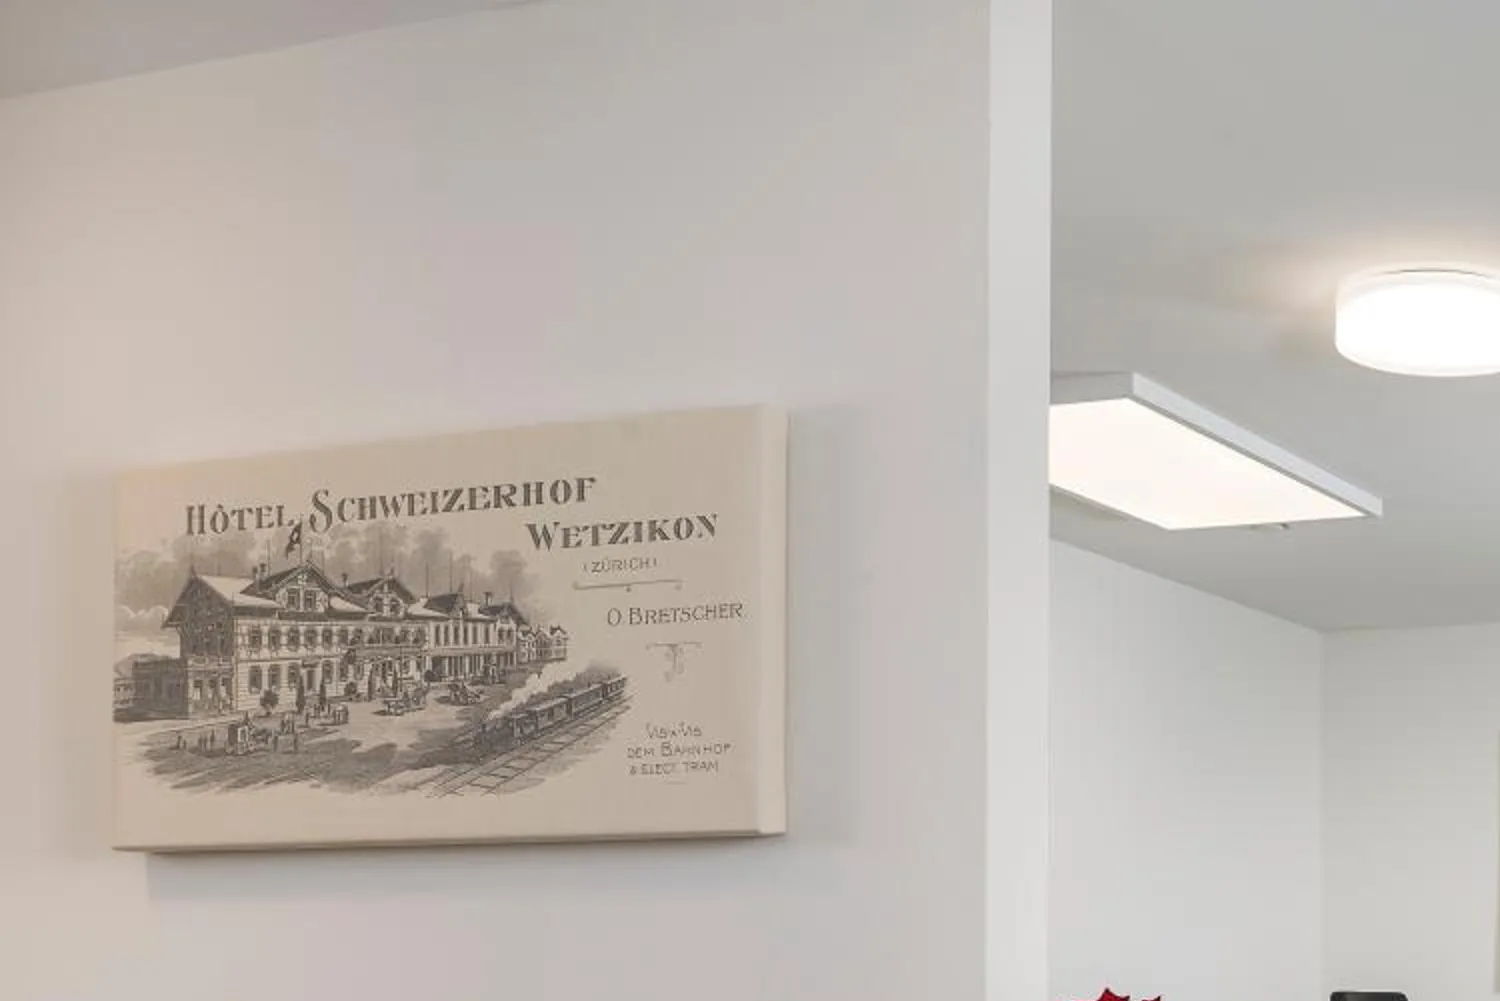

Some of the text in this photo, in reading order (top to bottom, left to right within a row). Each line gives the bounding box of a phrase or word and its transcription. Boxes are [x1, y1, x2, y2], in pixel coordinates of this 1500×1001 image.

[308, 477, 596, 534] SCHWEIZERHOF
[524, 513, 718, 551] WETZIKON
[629, 602, 744, 626] BRETSCHER
